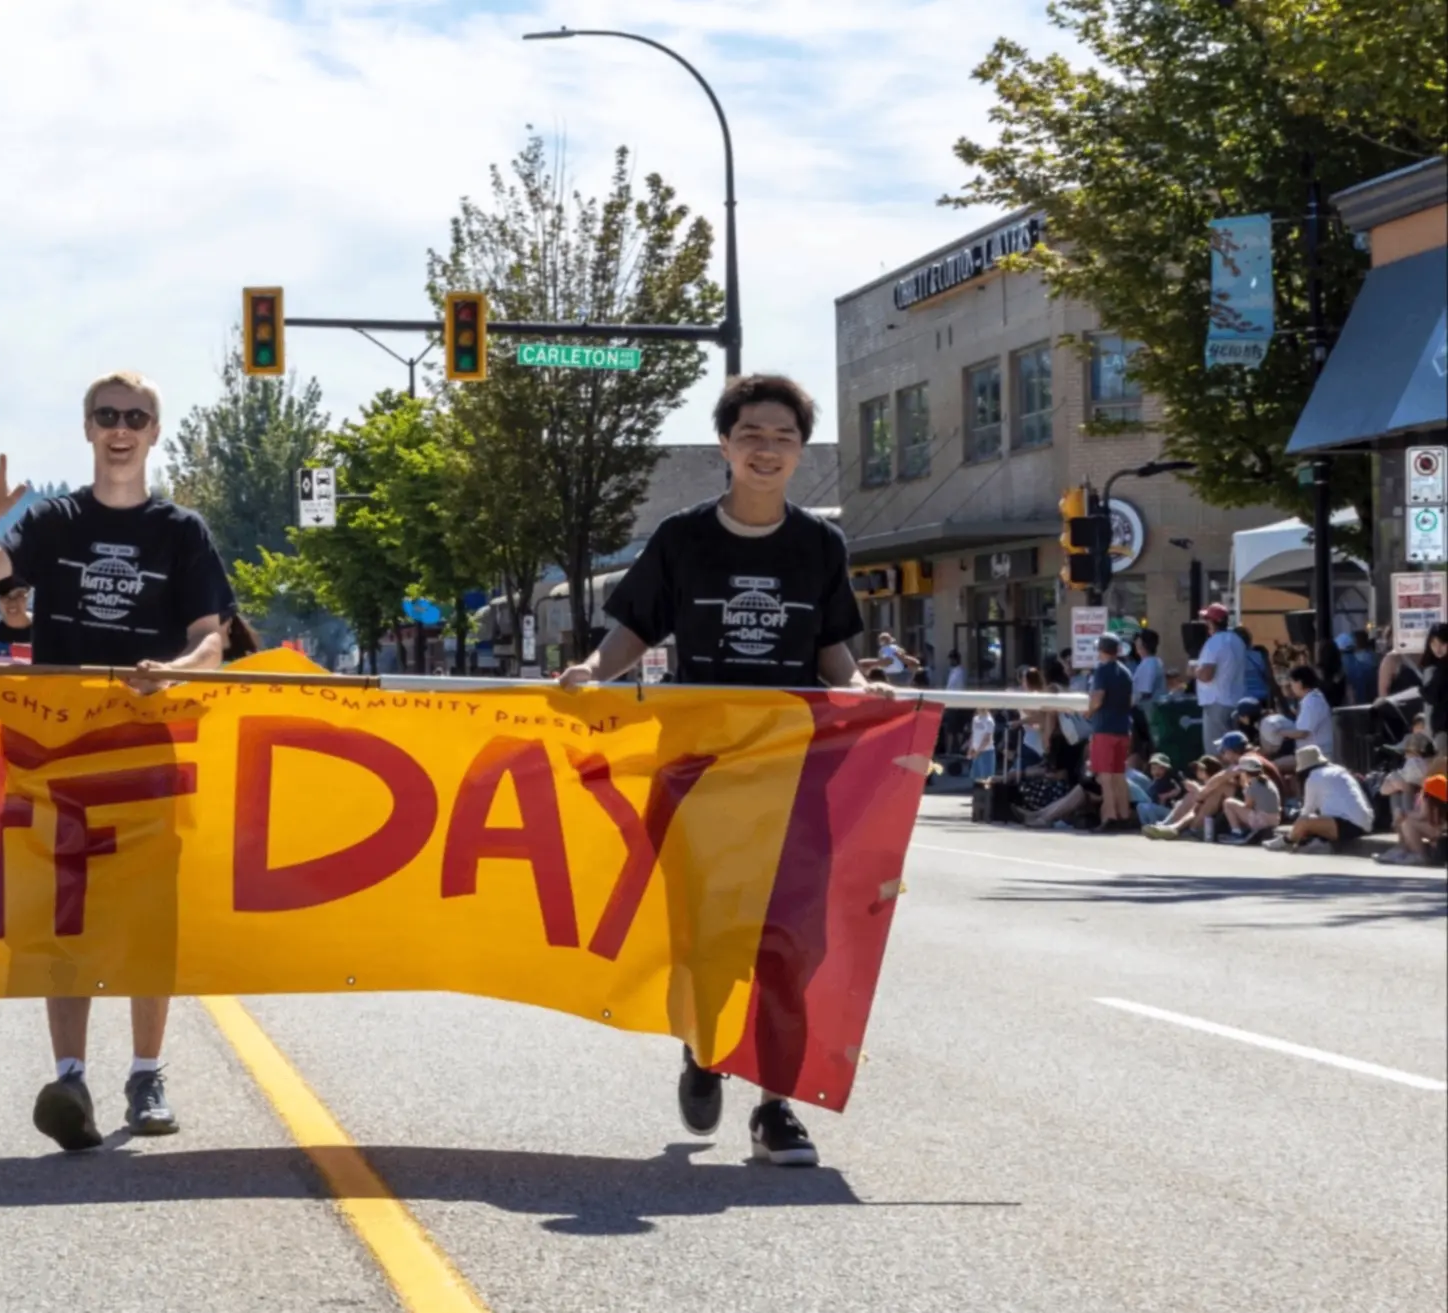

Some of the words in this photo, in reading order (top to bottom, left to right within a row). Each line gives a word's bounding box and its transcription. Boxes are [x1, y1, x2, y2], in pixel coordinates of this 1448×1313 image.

[522, 346, 618, 366] CARLETON
[80, 576, 114, 592] HATS
[117, 578, 145, 595] OFF
[722, 611, 757, 626] HATS
[760, 612, 789, 628] OFF
[268, 684, 283, 694] &
[299, 684, 481, 716] COMMUNITY
[495, 710, 620, 737] PRESENT
[233, 715, 718, 962] DAY
